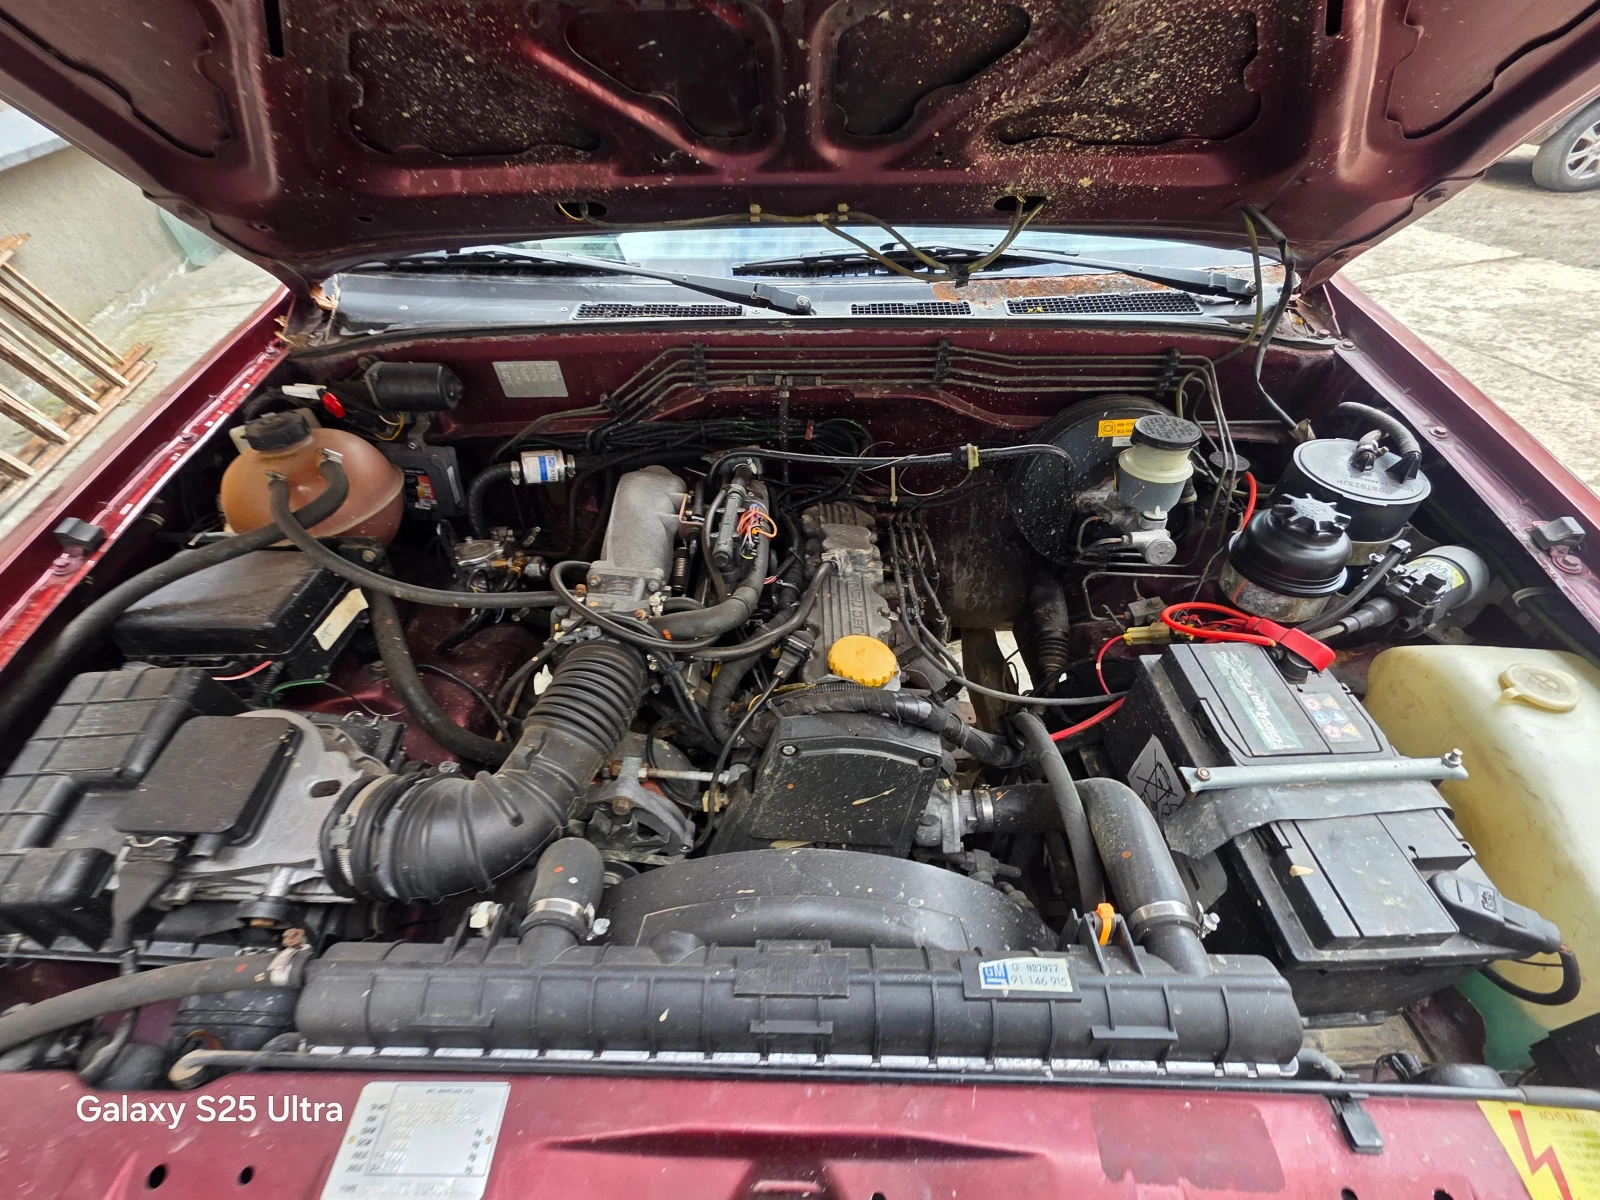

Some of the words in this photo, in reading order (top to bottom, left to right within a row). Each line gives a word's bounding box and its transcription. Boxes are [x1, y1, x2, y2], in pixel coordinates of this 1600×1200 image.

[984, 963, 1008, 981] GM
[1010, 974, 1024, 985] 91
[1028, 975, 1048, 986] 146
[1049, 976, 1068, 987] 915
